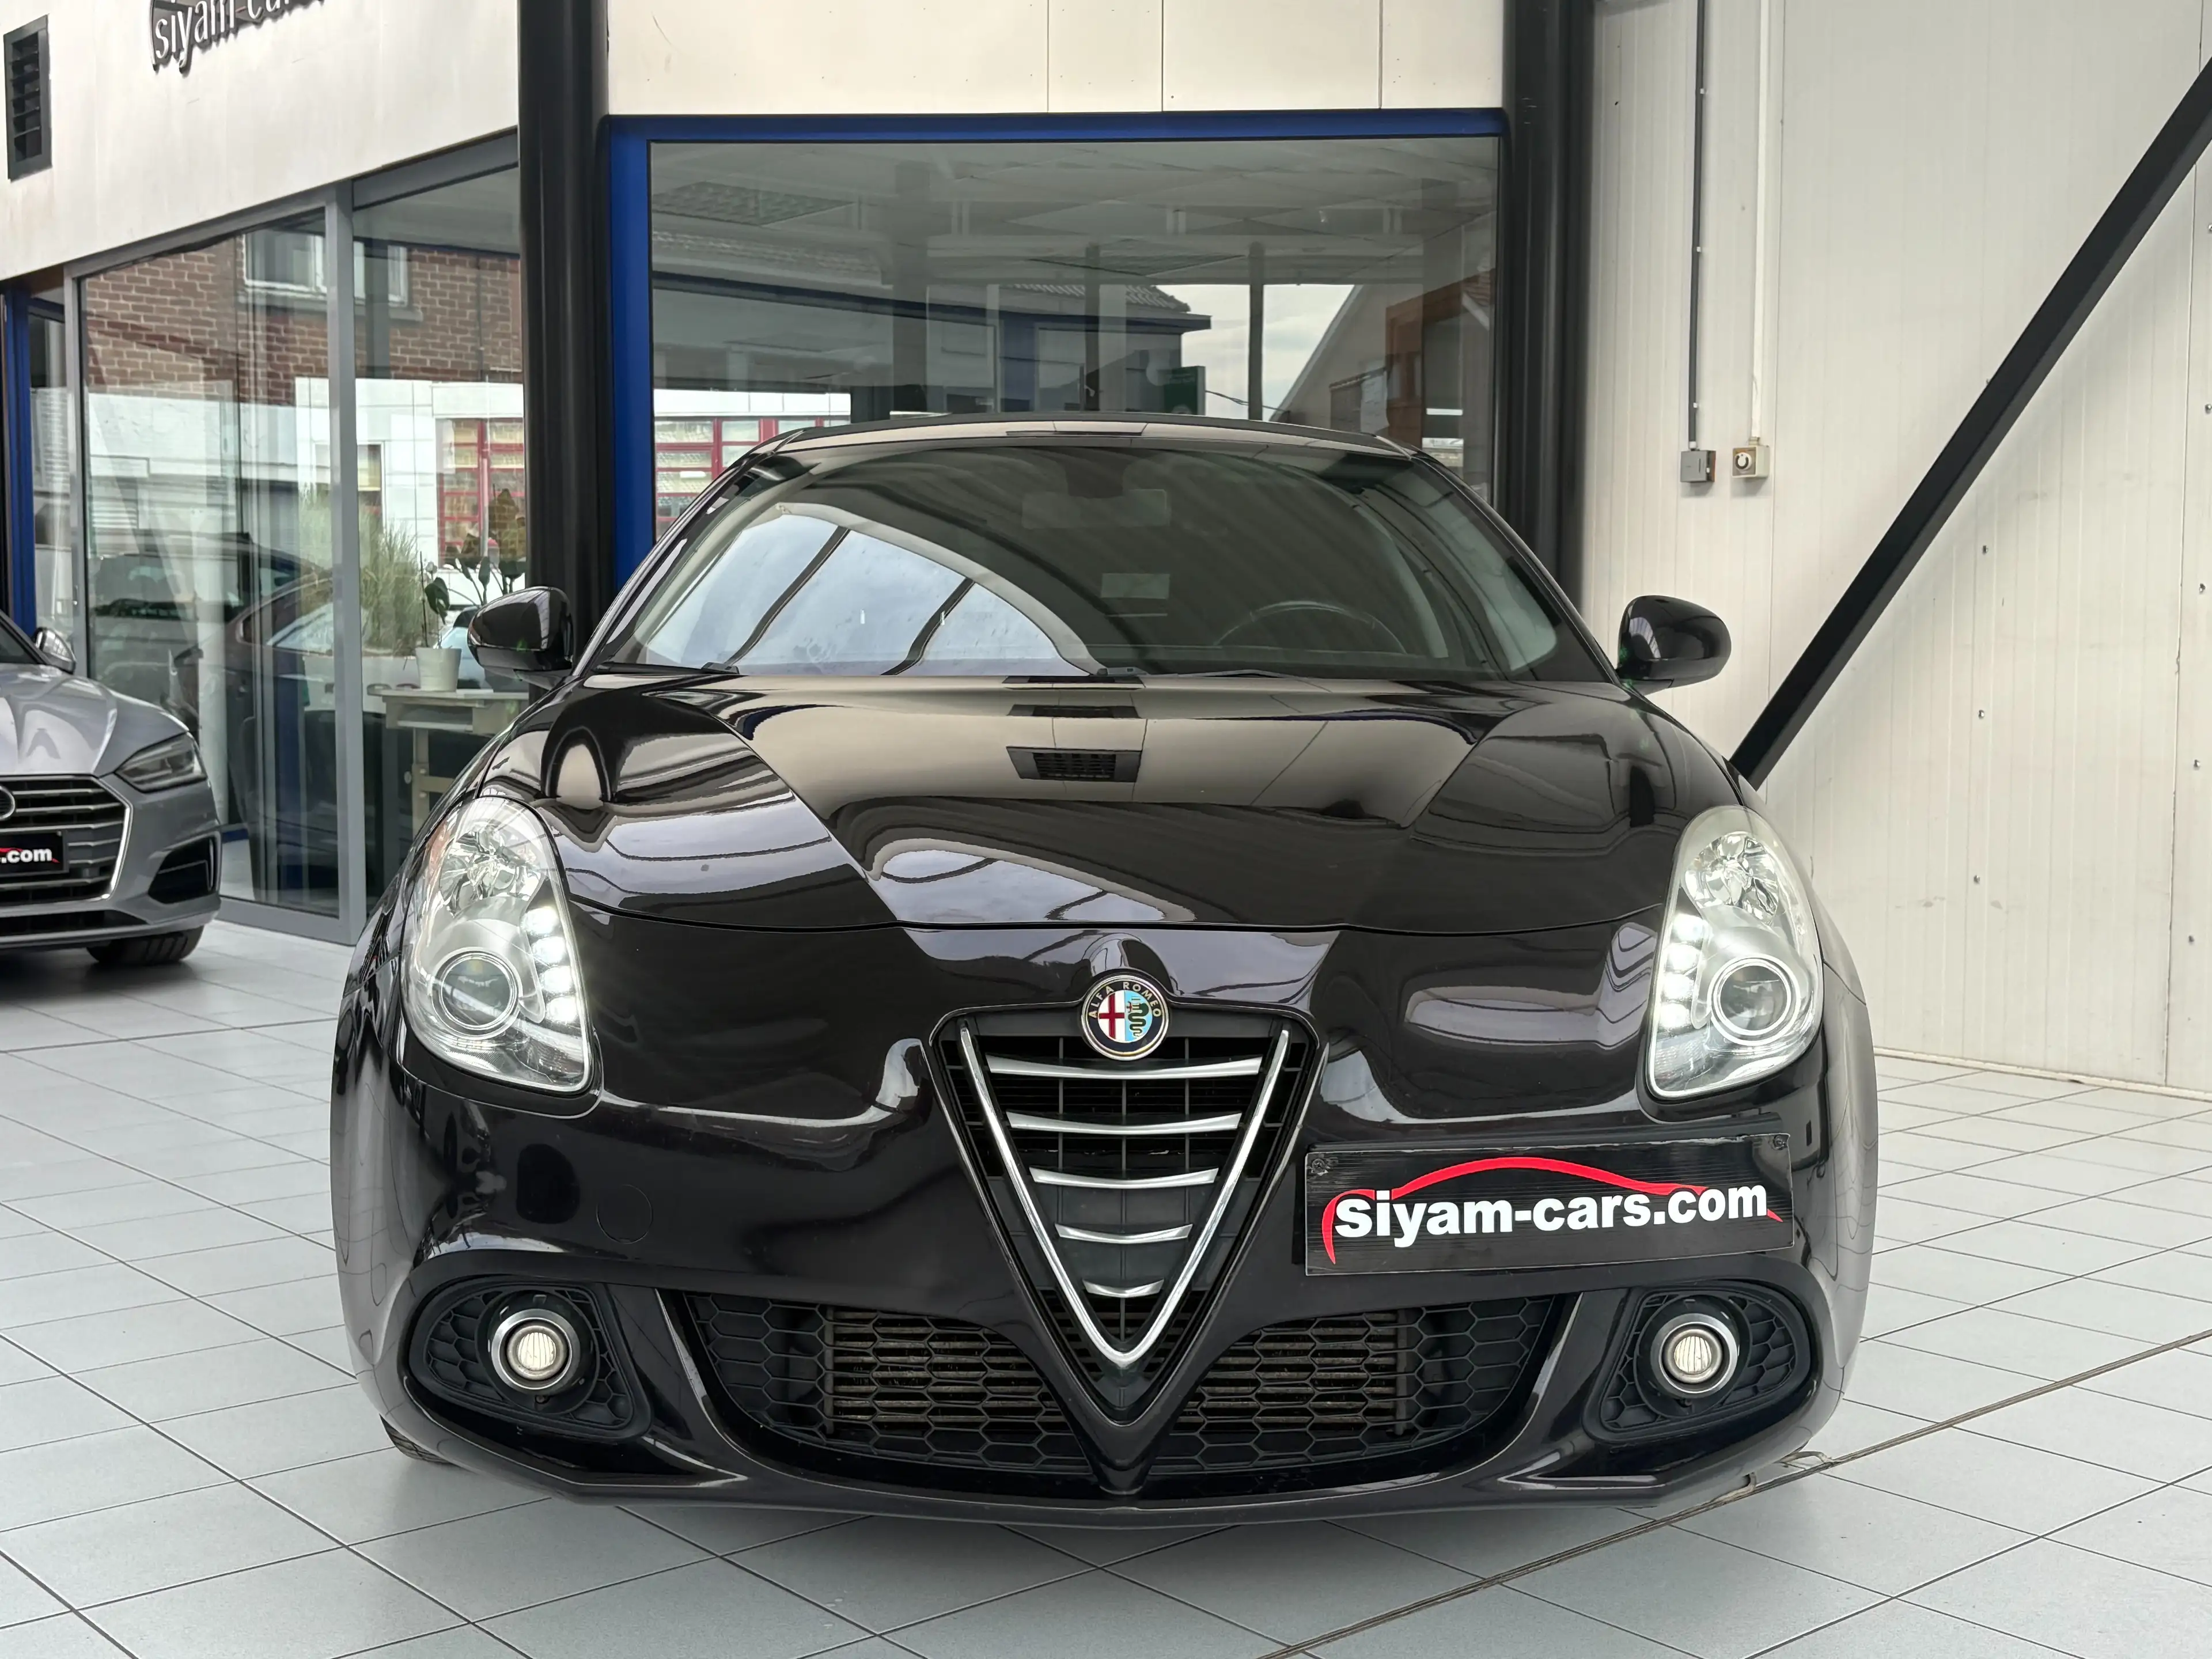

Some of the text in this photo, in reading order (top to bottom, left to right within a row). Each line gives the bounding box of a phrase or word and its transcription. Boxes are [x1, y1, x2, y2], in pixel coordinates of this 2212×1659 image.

[0, 848, 52, 863] .com
[1088, 982, 1162, 1019] ALFA ROMEO
